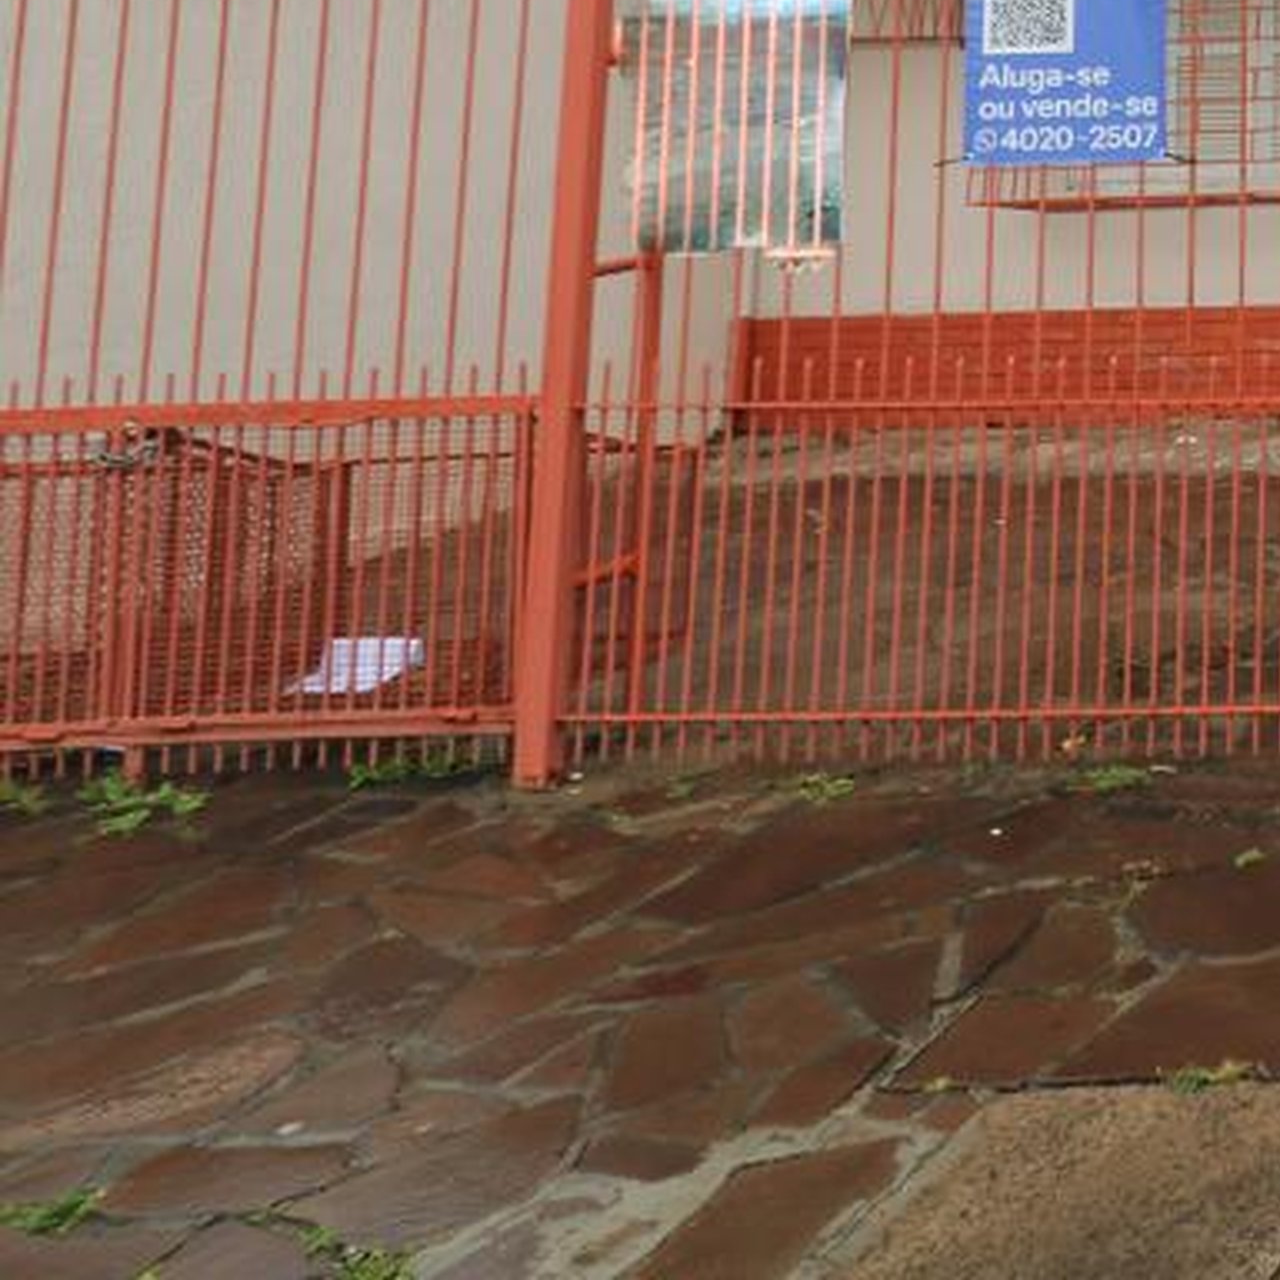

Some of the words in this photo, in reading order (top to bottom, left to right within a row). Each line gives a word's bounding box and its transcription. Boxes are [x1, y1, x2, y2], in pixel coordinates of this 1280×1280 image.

[979, 63, 1111, 94] Aluga-se
[978, 100, 1014, 119] ou
[1021, 93, 1158, 118] vende-se
